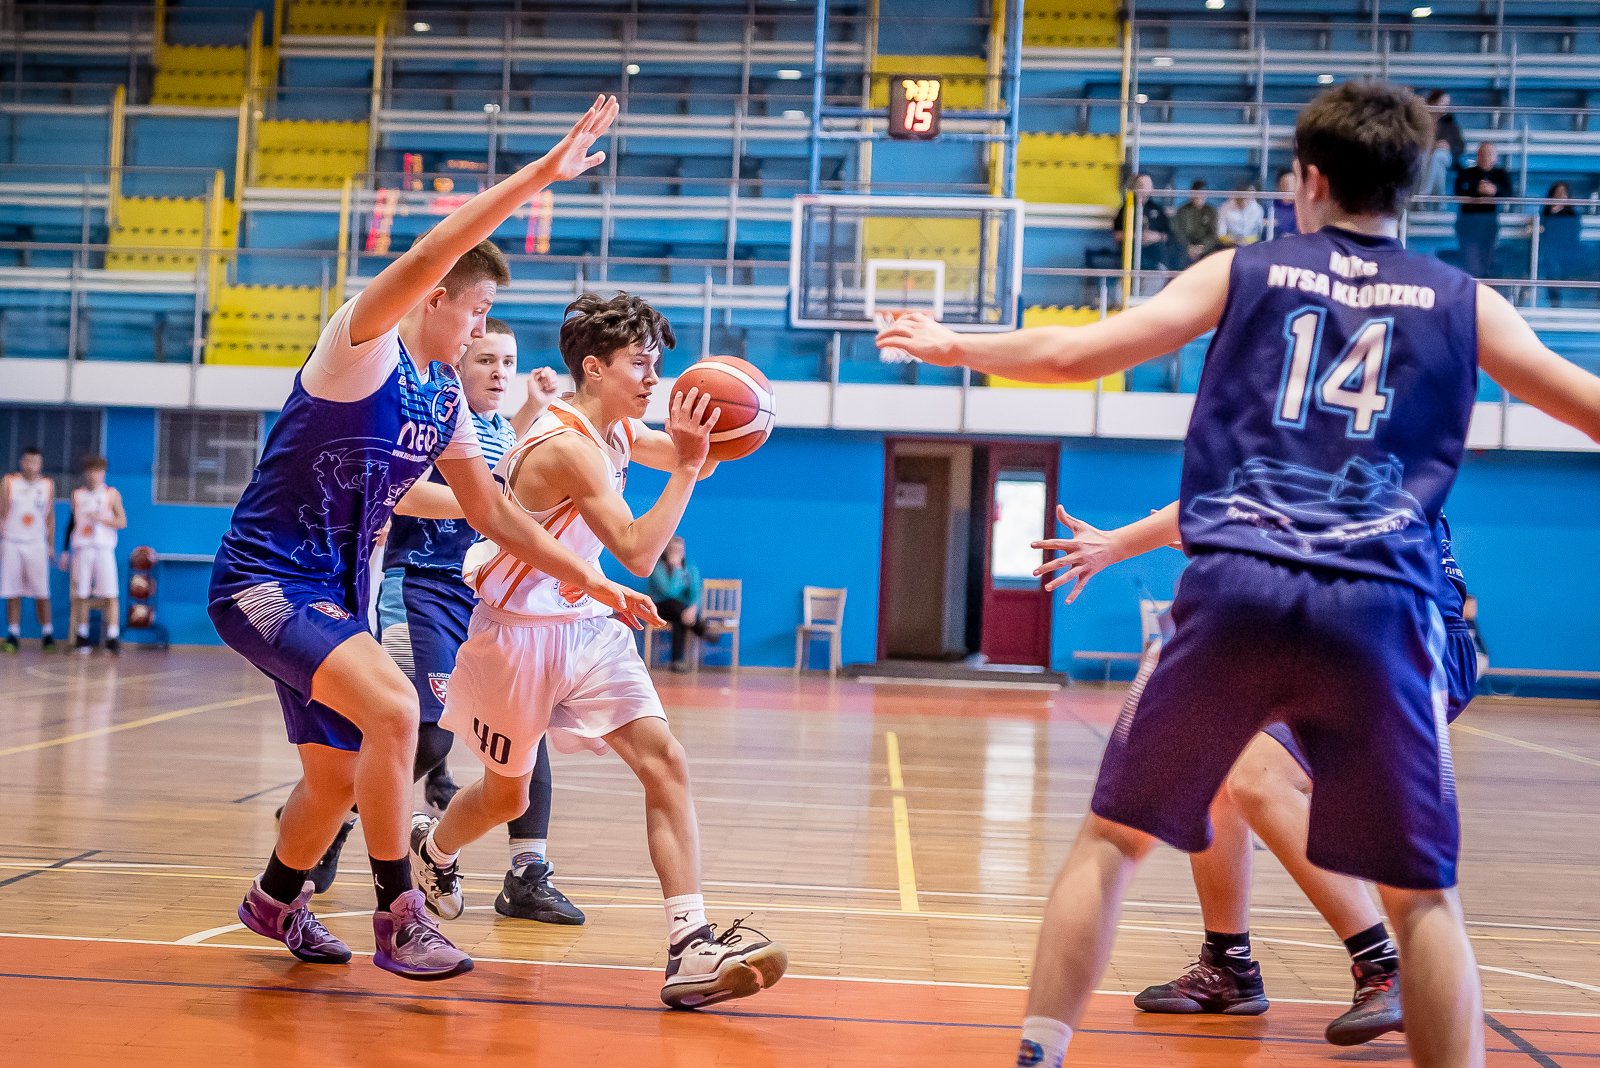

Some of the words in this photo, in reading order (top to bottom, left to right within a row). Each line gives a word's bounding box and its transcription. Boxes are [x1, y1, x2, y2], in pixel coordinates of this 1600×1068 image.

[904, 101, 933, 131] 15
[1267, 264, 1330, 296] NYSA
[1272, 305, 1395, 440] 14
[473, 717, 512, 765] 40
